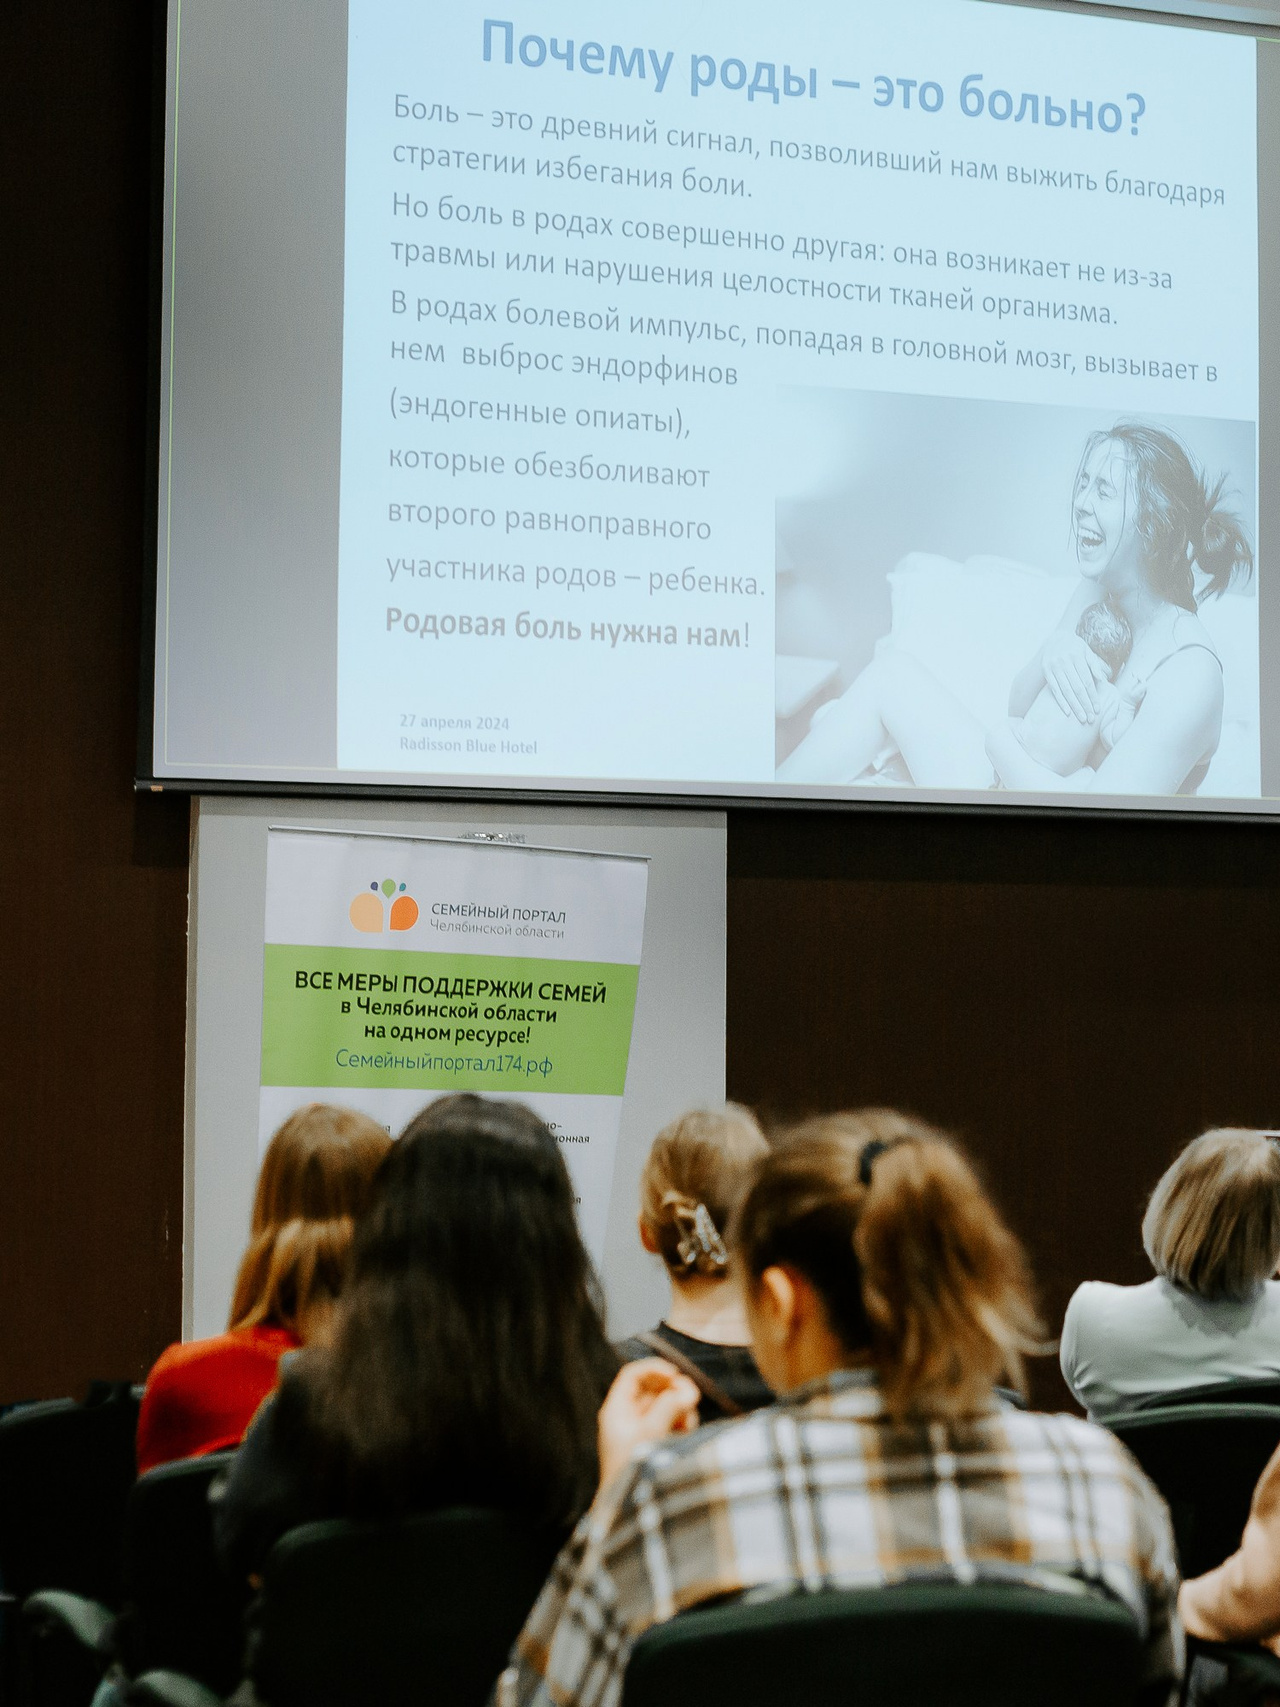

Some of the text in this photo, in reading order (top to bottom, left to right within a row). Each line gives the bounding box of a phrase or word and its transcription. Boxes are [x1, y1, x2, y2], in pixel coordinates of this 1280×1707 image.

[482, 18, 675, 94] Почему
[690, 53, 818, 105] роды
[873, 74, 945, 114] это
[959, 73, 1147, 137] больно?
[394, 93, 459, 124] Боль
[491, 110, 534, 131] это
[540, 115, 657, 145] древний
[666, 129, 760, 160] сигнал,
[769, 139, 942, 175] позволивший
[950, 159, 998, 181] нам
[1006, 165, 1098, 192] выжить
[1105, 169, 1225, 209] благодаря
[392, 144, 752, 198] стратегии избегания боли.
[393, 191, 1173, 290] Но боль в родах совершенно другая: она возникает не из-за
[390, 241, 1118, 325] травмы или нарушения целостности тканей организма.
[391, 289, 1218, 383] В родах болевой импульс, попадая в головной мозг, вызывает в
[391, 340, 738, 386] нем выброс эндорфинов
[390, 386, 690, 439] (эндогенные опиаты),
[389, 449, 710, 488] которые обезболивают
[388, 503, 712, 540] второго равноправного
[386, 558, 525, 582] участника
[536, 566, 616, 592] родов
[649, 566, 765, 596] ребенка.
[386, 607, 749, 648] Родовая боль нужна нам!
[400, 714, 509, 730] 27 апреля 2024
[400, 737, 537, 754] Radisson Blue Hotel
[431, 919, 564, 938] Челябинской области
[432, 902, 566, 924] СЕМЕЙНЫЙ ПОРТАЛ
[295, 971, 607, 1003] ВСЕ МЕРЫ ПОДДЕРЖКИ СЕМЕЙ
[341, 997, 557, 1023] в Челябинской области
[364, 1023, 530, 1047] на одном ресурсе!
[336, 1049, 553, 1077] Семейныйпортал174.рф
